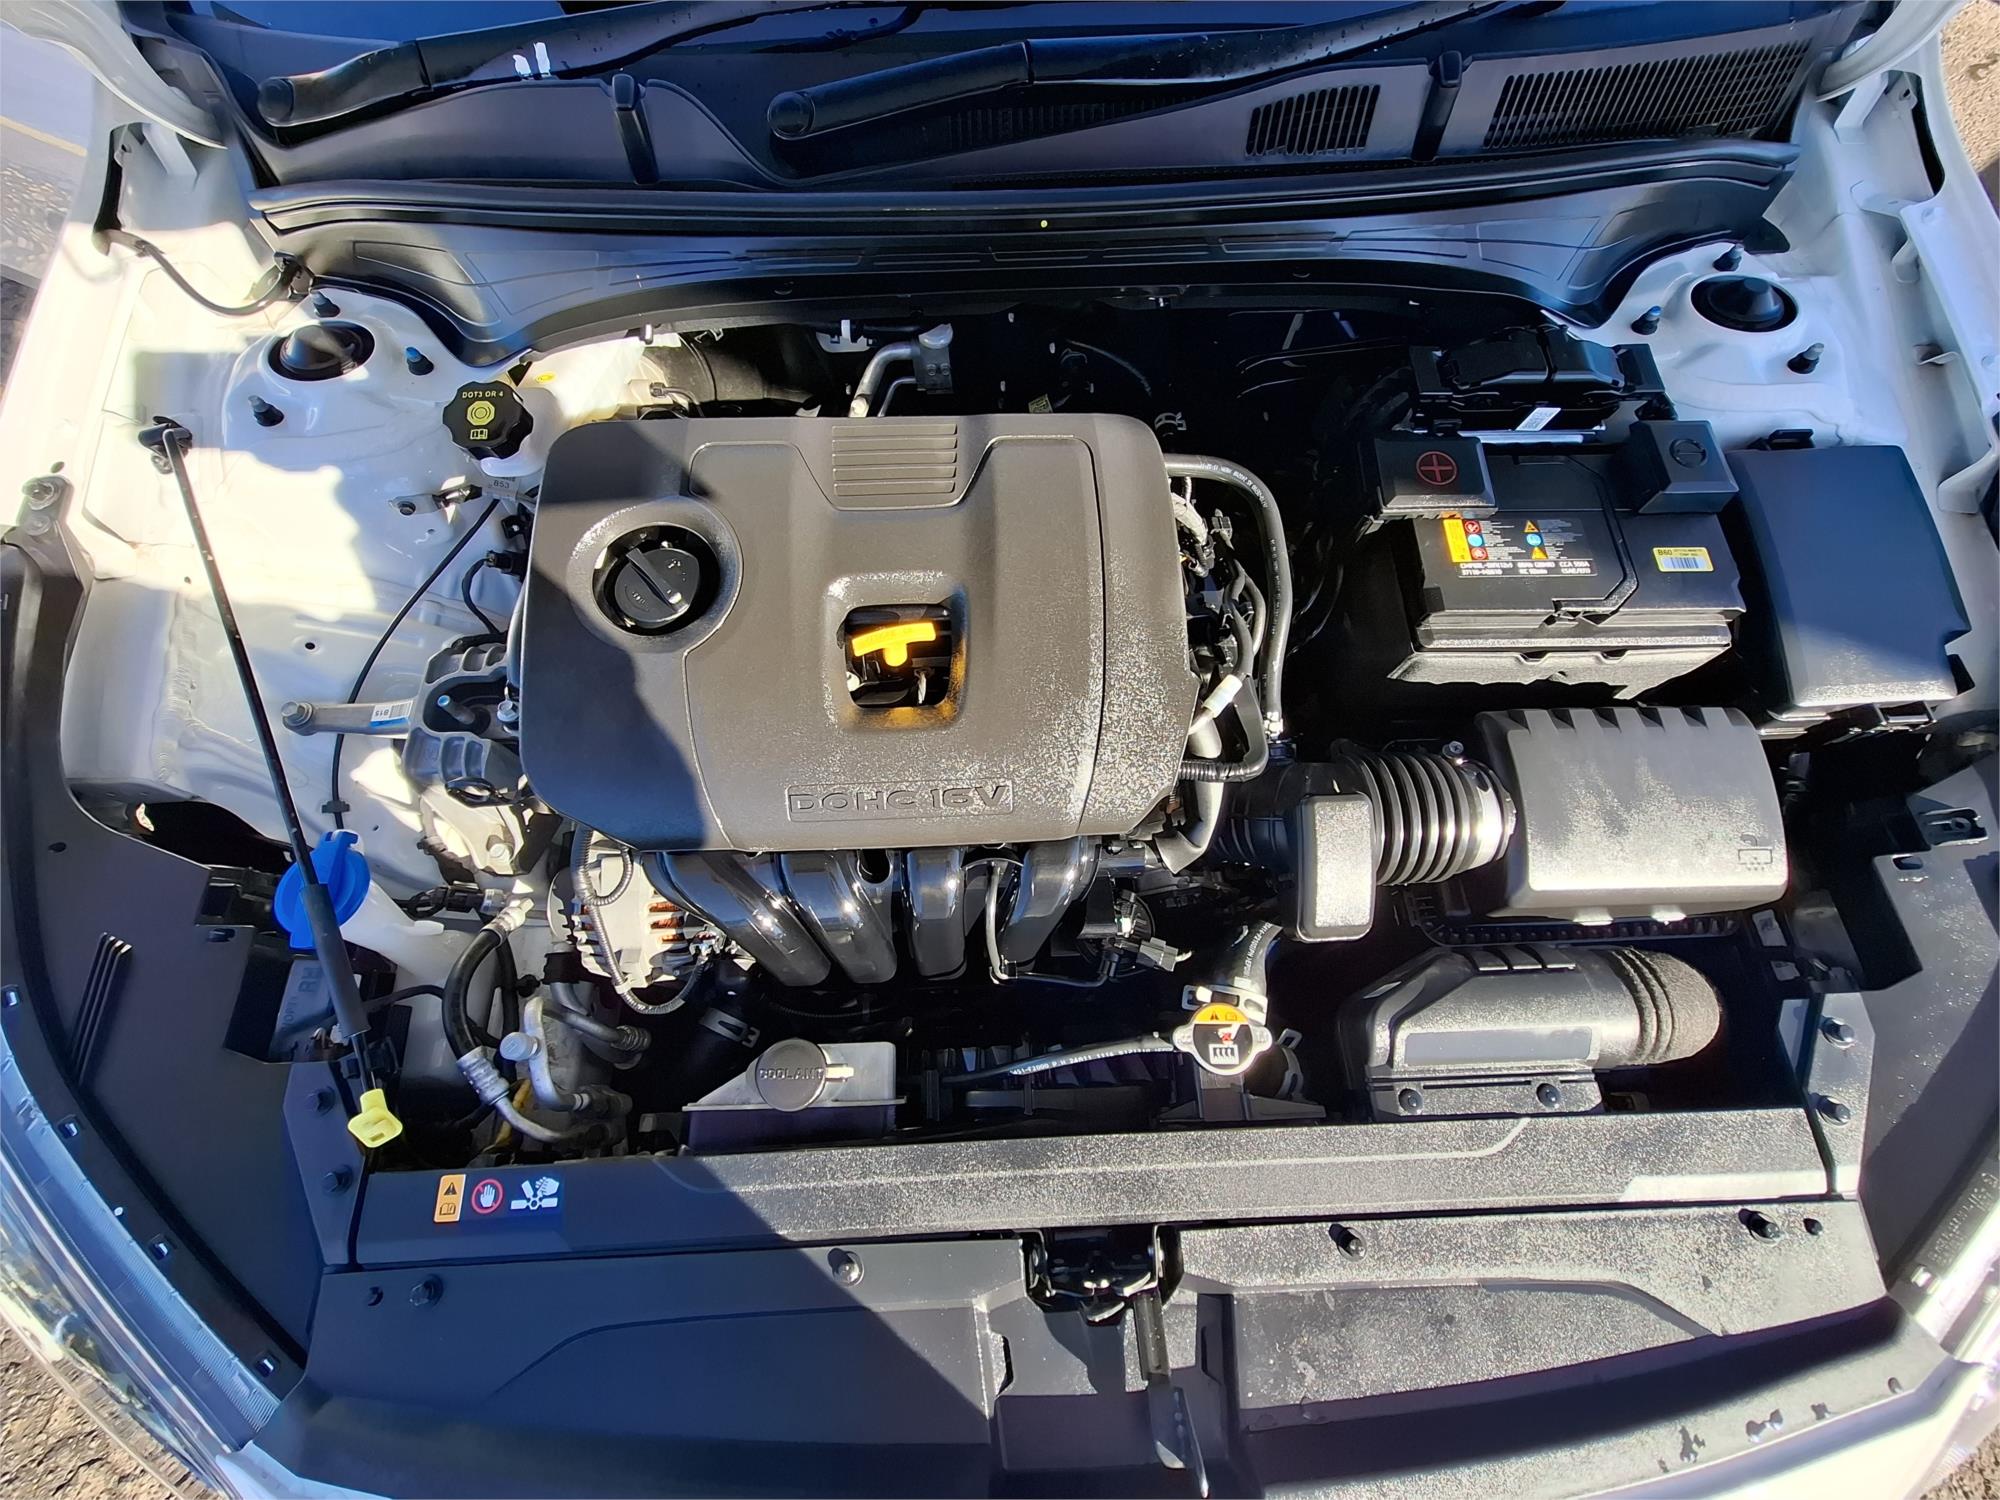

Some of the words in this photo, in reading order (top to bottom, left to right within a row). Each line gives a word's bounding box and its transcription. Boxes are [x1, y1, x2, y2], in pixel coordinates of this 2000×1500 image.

[462, 391, 483, 399] DOT3
[485, 390, 497, 398] OR
[788, 789, 916, 813] DOHC
[929, 785, 1010, 808] 16V
[759, 1067, 825, 1080] COOLANT
